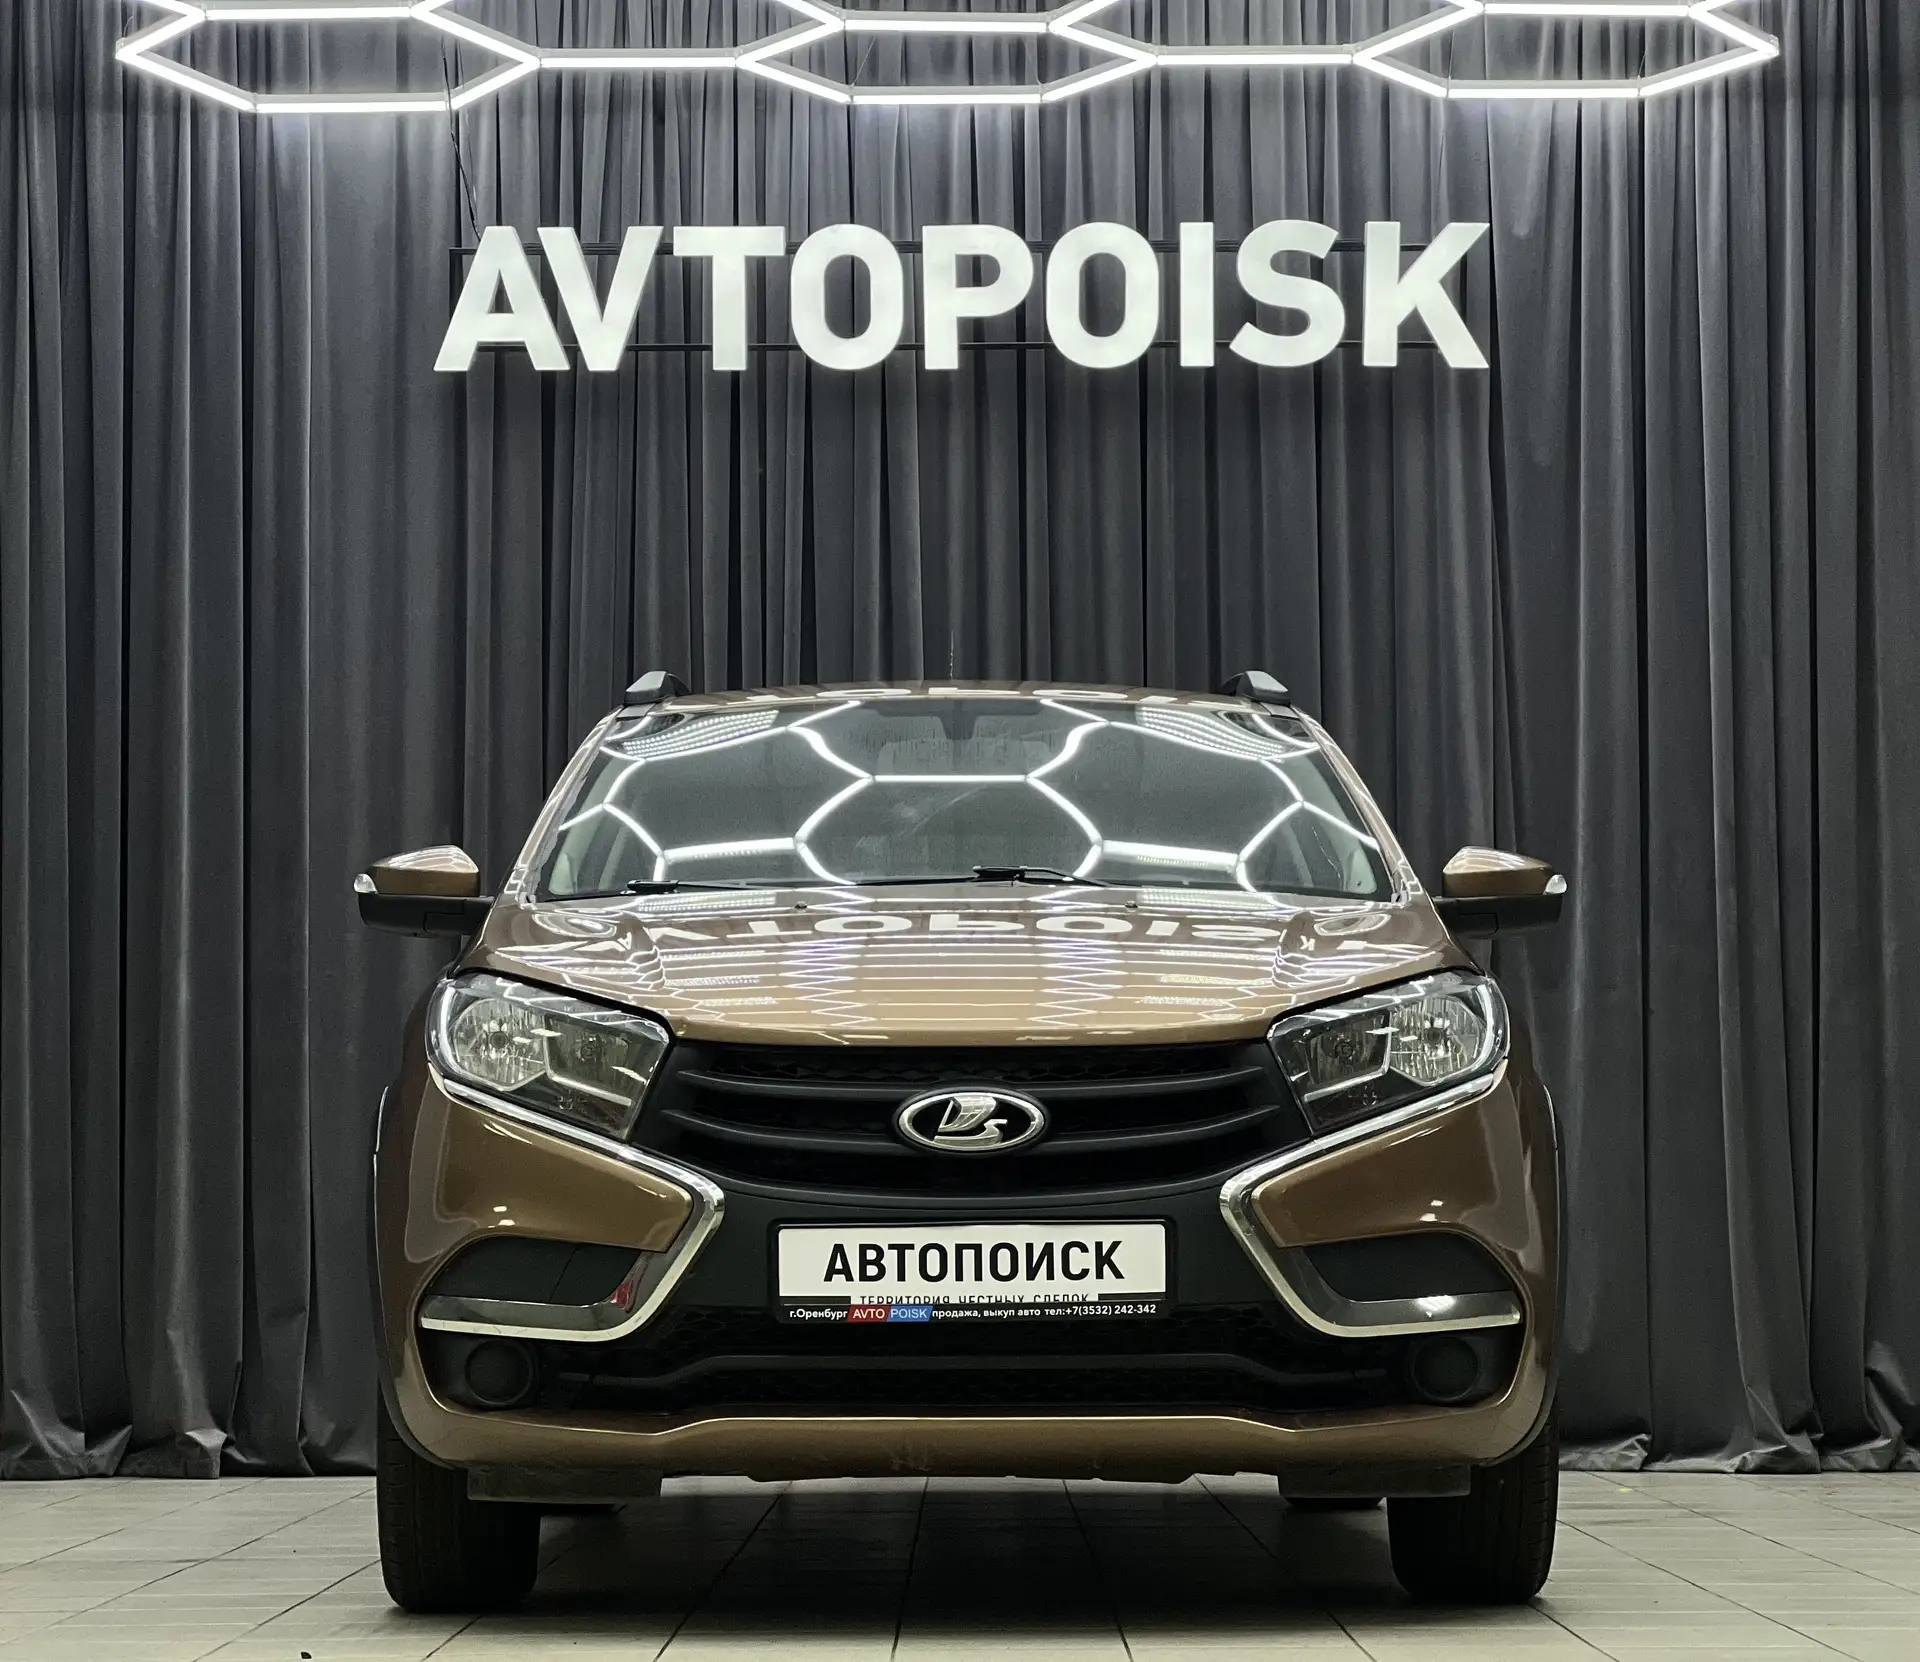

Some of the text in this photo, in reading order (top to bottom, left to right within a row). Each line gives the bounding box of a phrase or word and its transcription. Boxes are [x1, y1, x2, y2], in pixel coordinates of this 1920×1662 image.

[434, 220, 1490, 372] AVTOPOISK
[823, 1240, 1125, 1283] АВТОПОИСК
[789, 1308, 848, 1320] г.Оренбург
[852, 1308, 886, 1319] AVTO
[890, 1308, 928, 1319] POISK
[931, 1309, 981, 1320] продажа,
[983, 1308, 1015, 1319] выкуп
[1017, 1308, 1041, 1316] авто
[1114, 1304, 1157, 1315] 242-342
